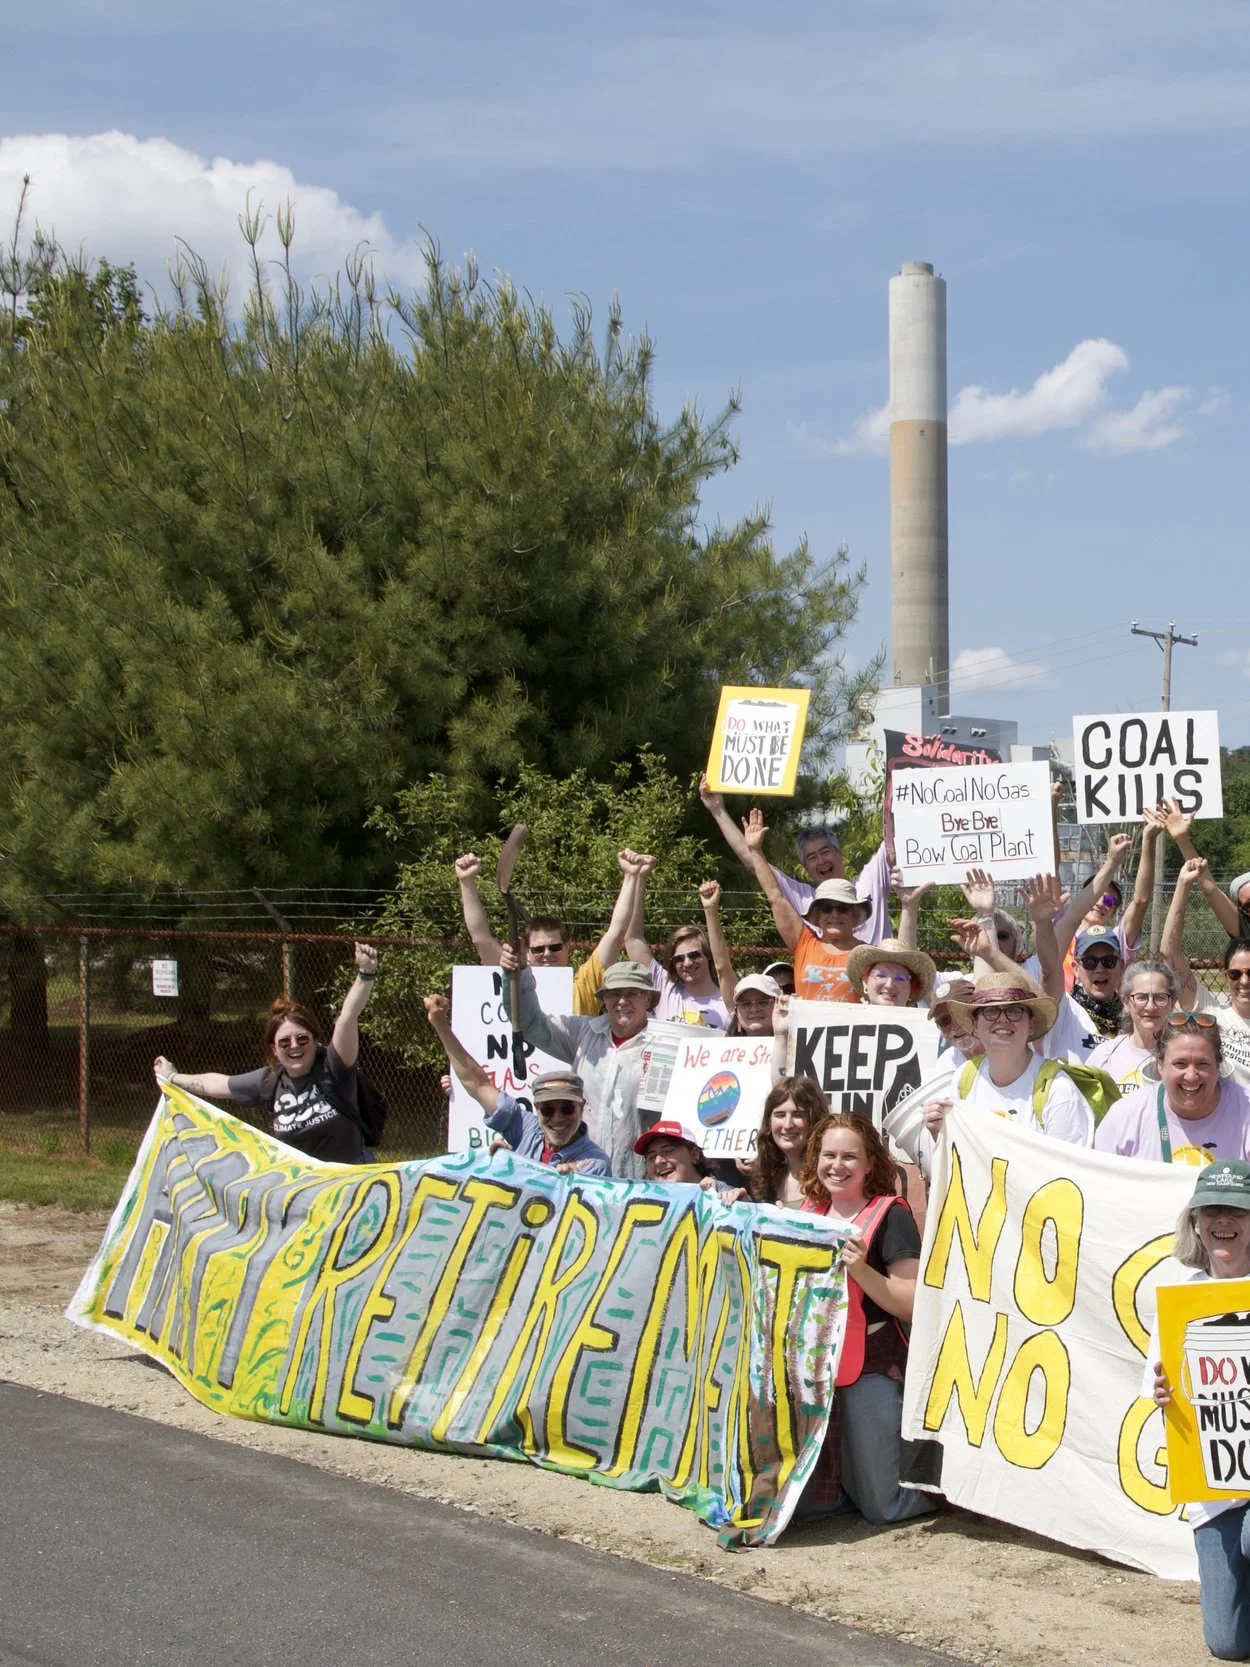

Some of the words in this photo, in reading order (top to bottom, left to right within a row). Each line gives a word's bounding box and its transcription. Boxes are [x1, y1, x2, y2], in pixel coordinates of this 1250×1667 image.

[728, 716, 746, 731] DO
[753, 719, 790, 734] WHAT
[725, 731, 766, 755] MUST
[770, 735, 789, 756] BE
[1081, 718, 1209, 770] COAL
[721, 754, 782, 787] DONE
[905, 838, 946, 865] Bow
[950, 834, 983, 862] Coal
[990, 828, 1034, 858] Plant
[683, 1045, 711, 1069] We
[720, 1047, 746, 1064] are
[794, 1024, 914, 1092] KEEP
[304, 1108, 339, 1128] JUSTICE
[924, 1141, 1085, 1327] NO
[922, 1298, 1072, 1470] NO
[1199, 1356, 1237, 1385] DO
